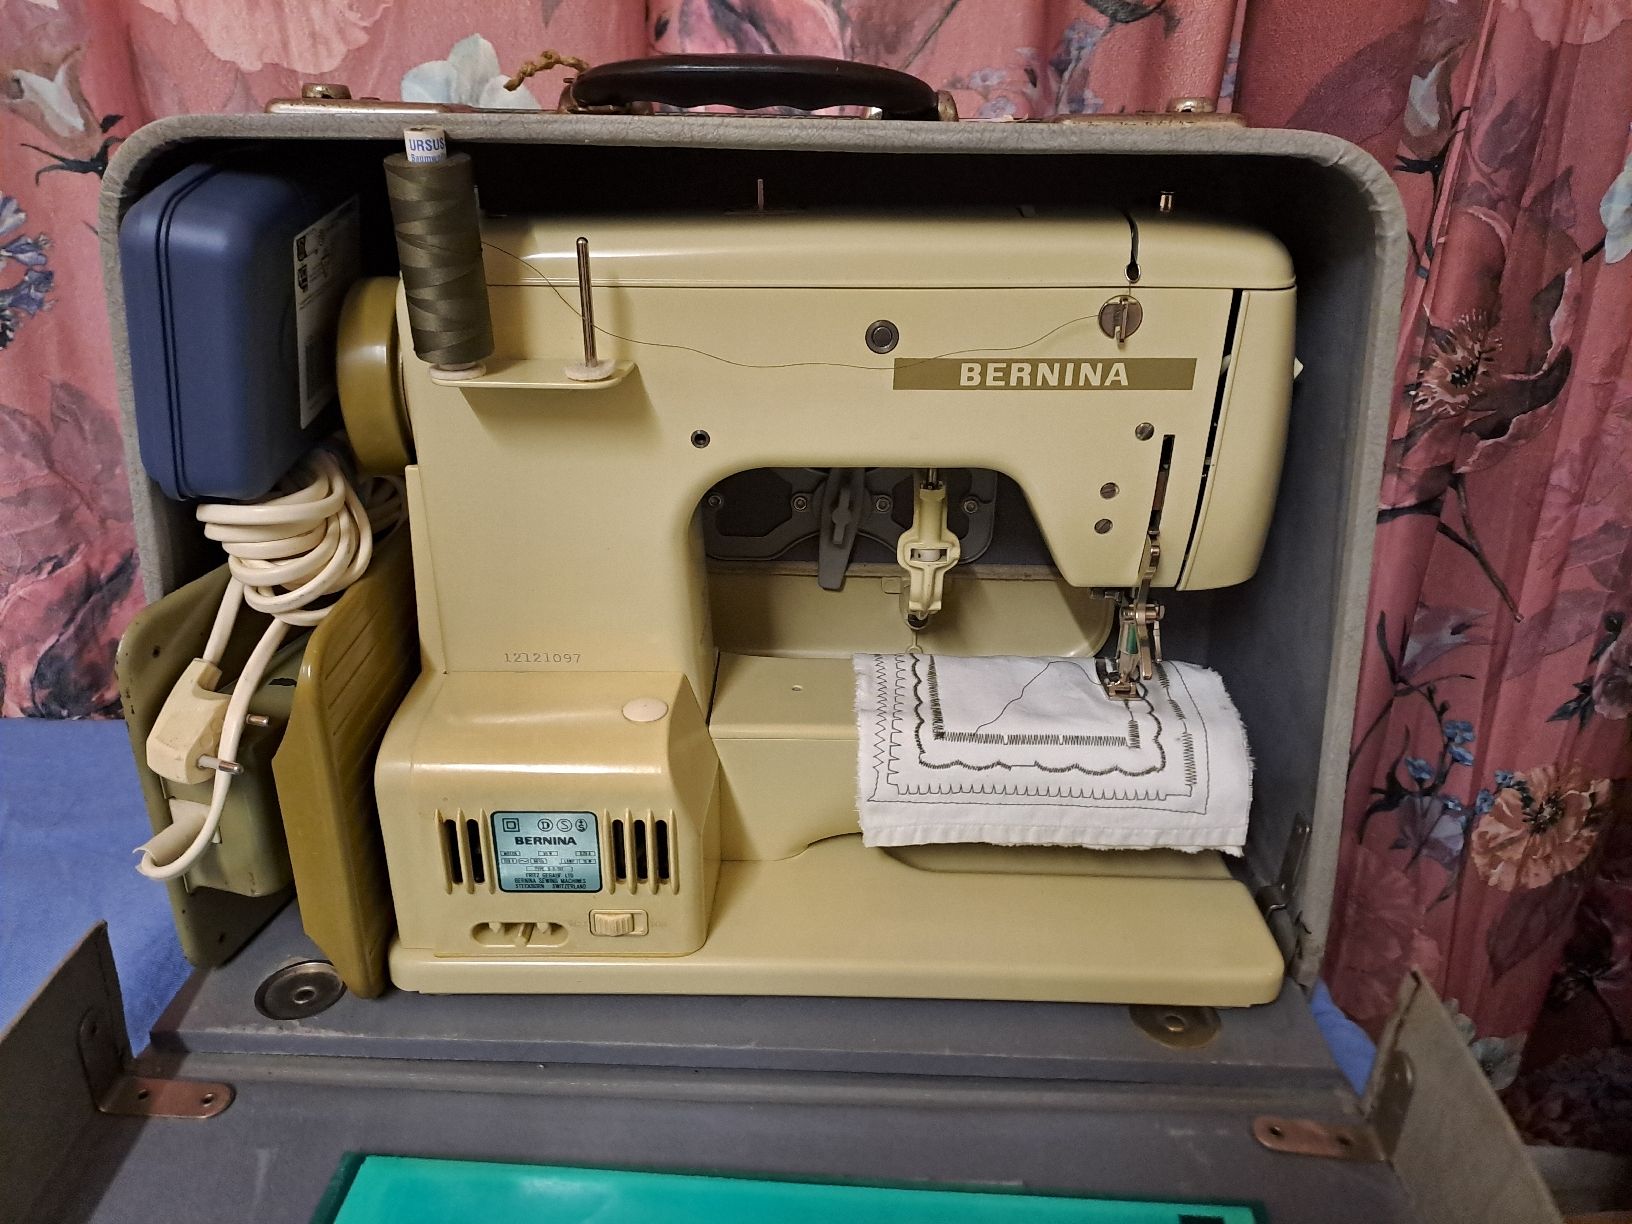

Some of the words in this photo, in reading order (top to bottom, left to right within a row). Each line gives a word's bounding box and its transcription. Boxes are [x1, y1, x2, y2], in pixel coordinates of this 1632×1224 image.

[409, 137, 445, 151] URSUS
[959, 362, 1129, 387] BERNINA
[504, 652, 581, 663] 12121097
[515, 837, 577, 845] BERNINA
